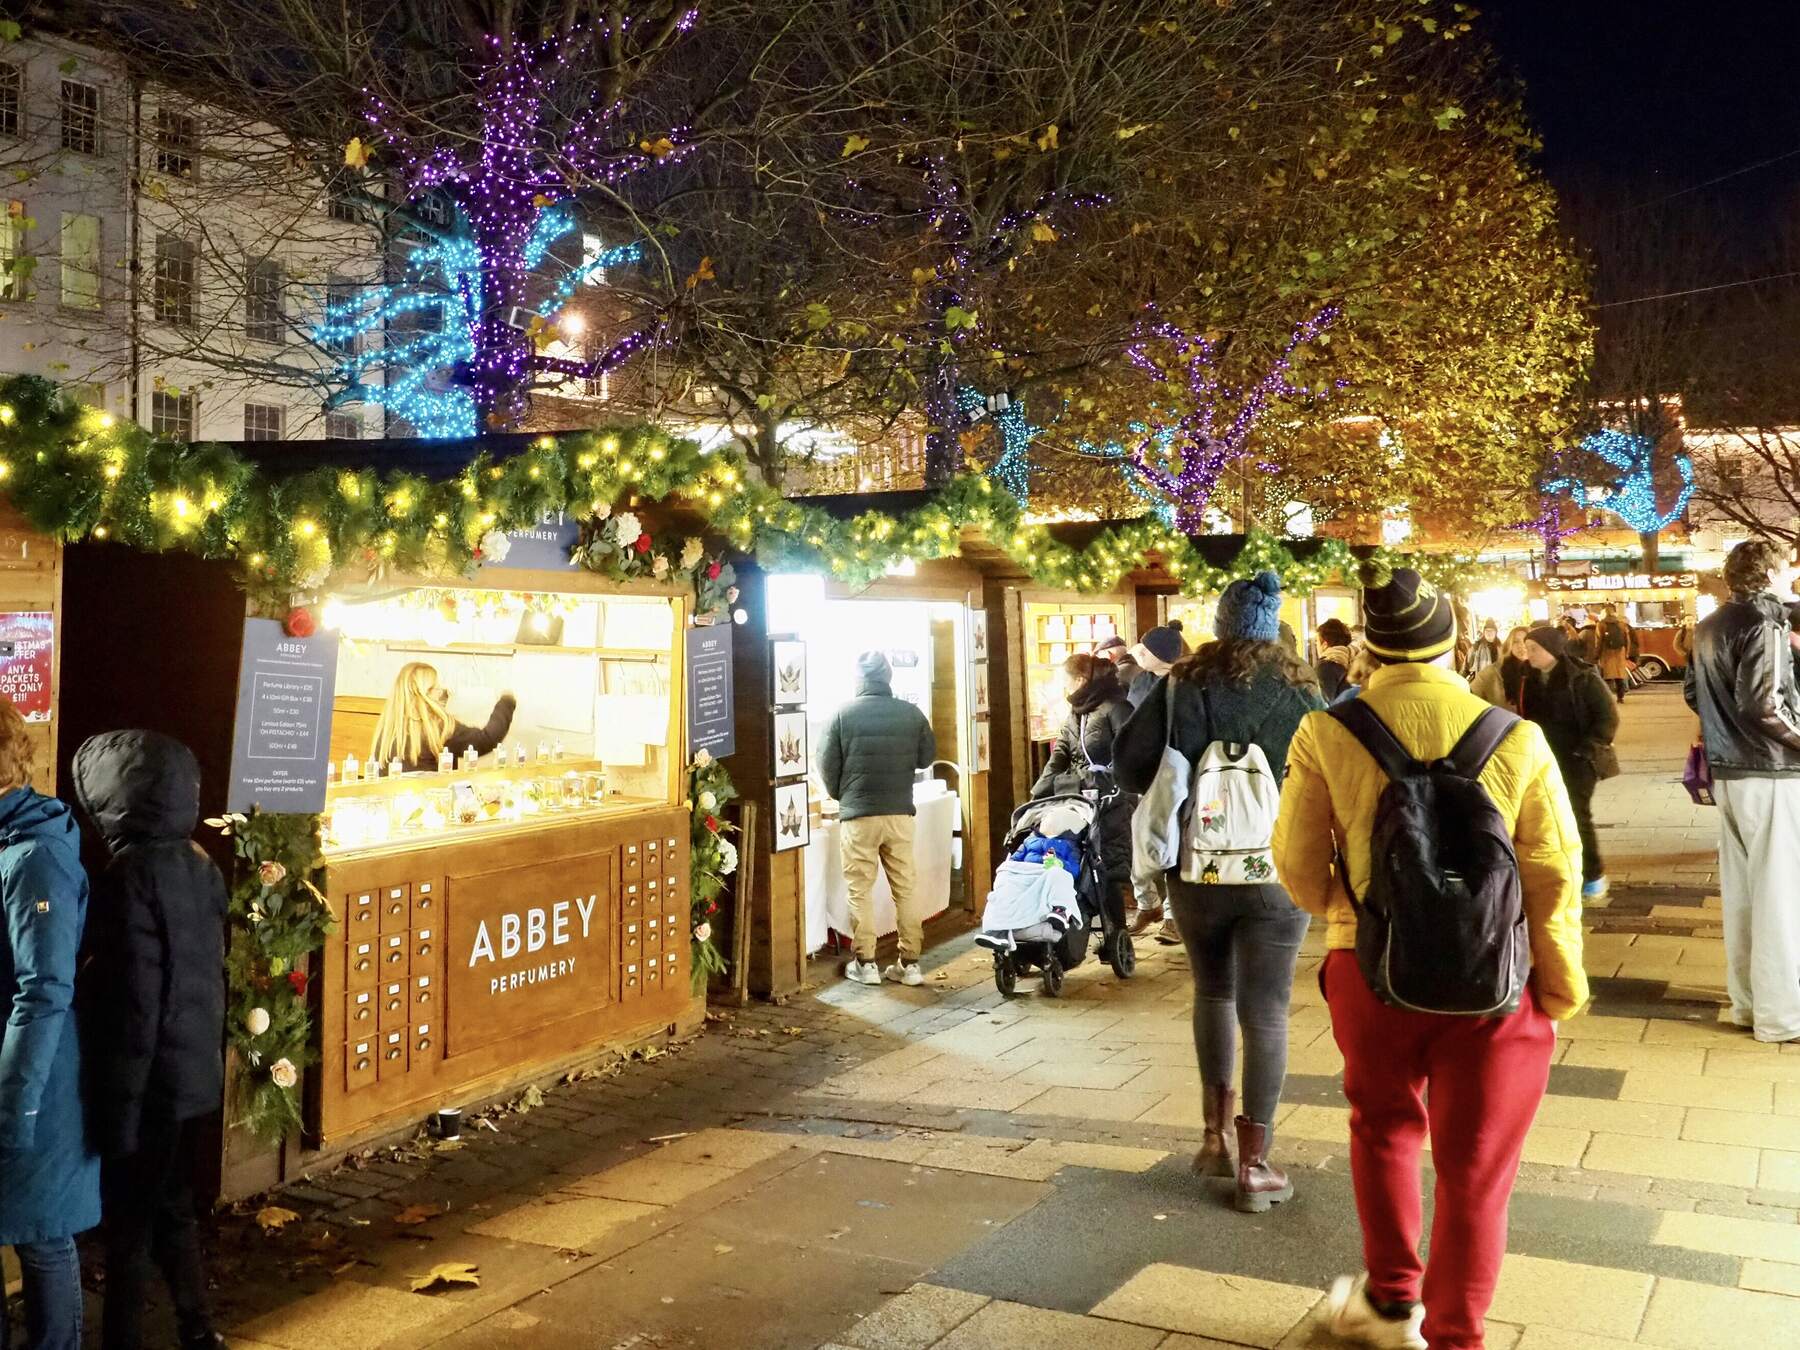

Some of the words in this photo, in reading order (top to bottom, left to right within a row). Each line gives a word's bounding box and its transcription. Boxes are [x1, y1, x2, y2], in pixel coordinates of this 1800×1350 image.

[276, 643, 307, 654] ABBEY
[8, 664, 25, 675] ANY
[28, 663, 34, 673] 4
[1, 673, 40, 684] PACKETS
[20, 682, 43, 693] ONLY
[468, 894, 597, 968] ABBEY
[490, 957, 576, 995] PERFUMERY
